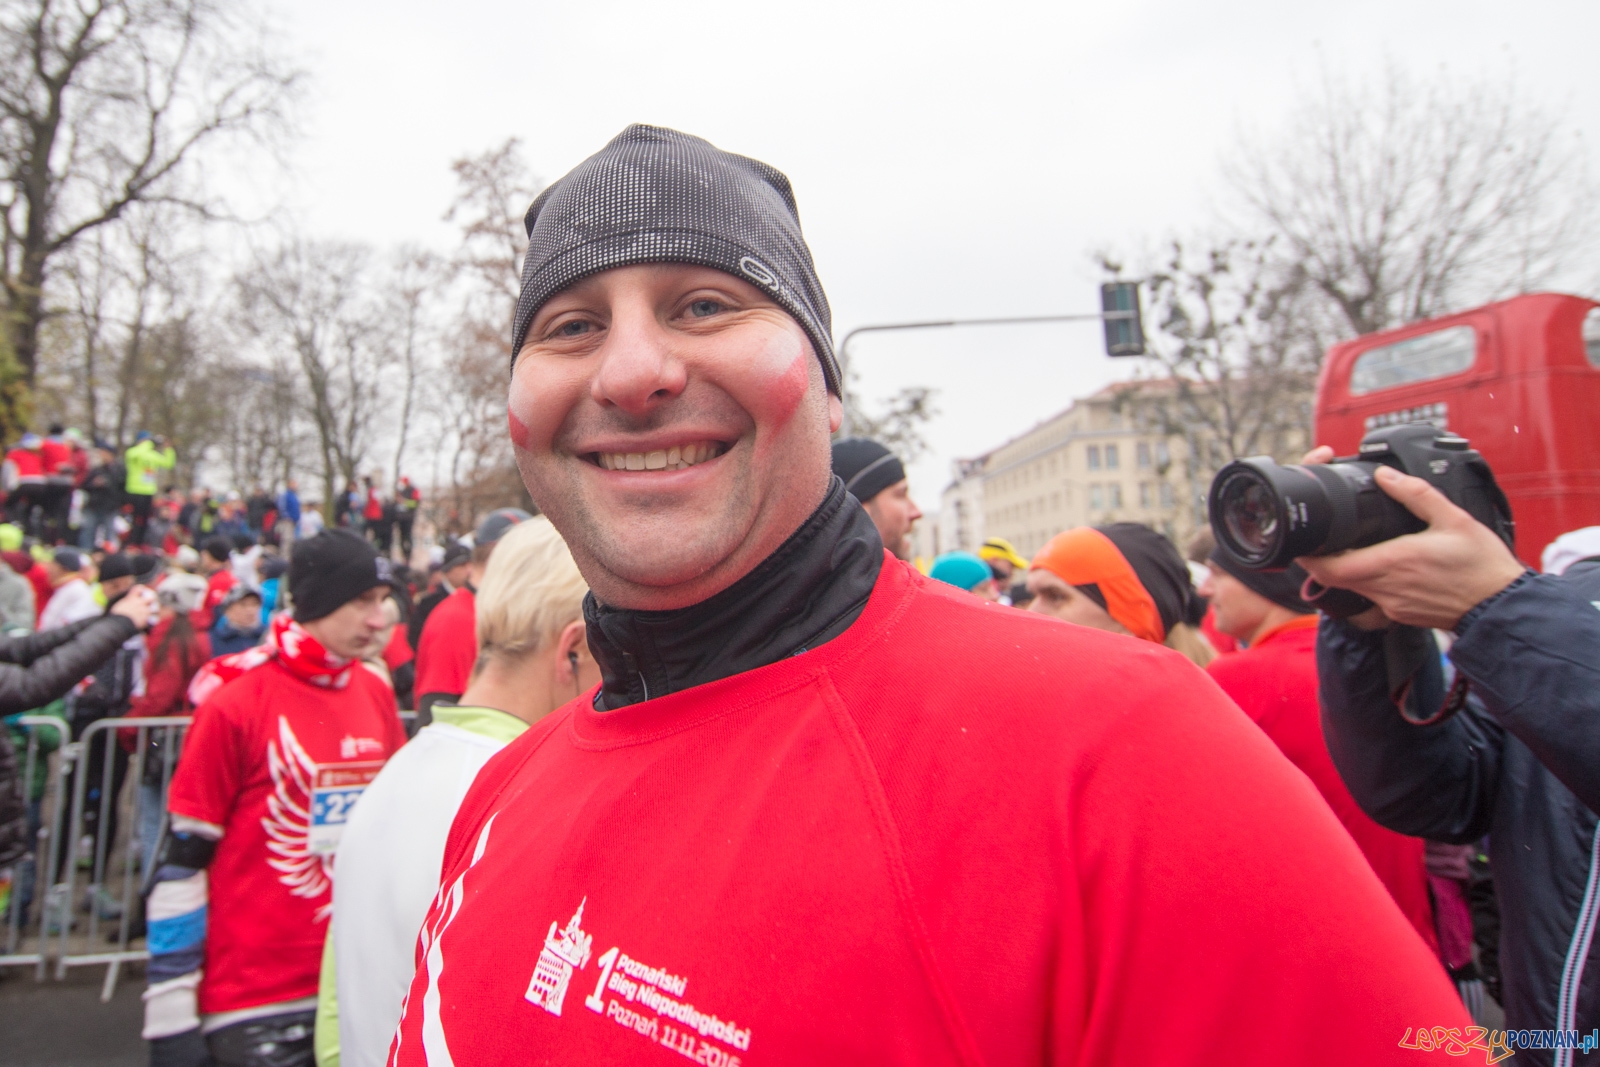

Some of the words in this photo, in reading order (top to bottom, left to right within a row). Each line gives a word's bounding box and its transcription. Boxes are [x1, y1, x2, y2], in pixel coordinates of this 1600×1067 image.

[585, 947, 619, 1014] 1
[616, 953, 688, 998] Poznański
[606, 999, 659, 1042] Poznań,
[607, 971, 638, 1002] Bieg
[636, 983, 751, 1051] Niepodległości
